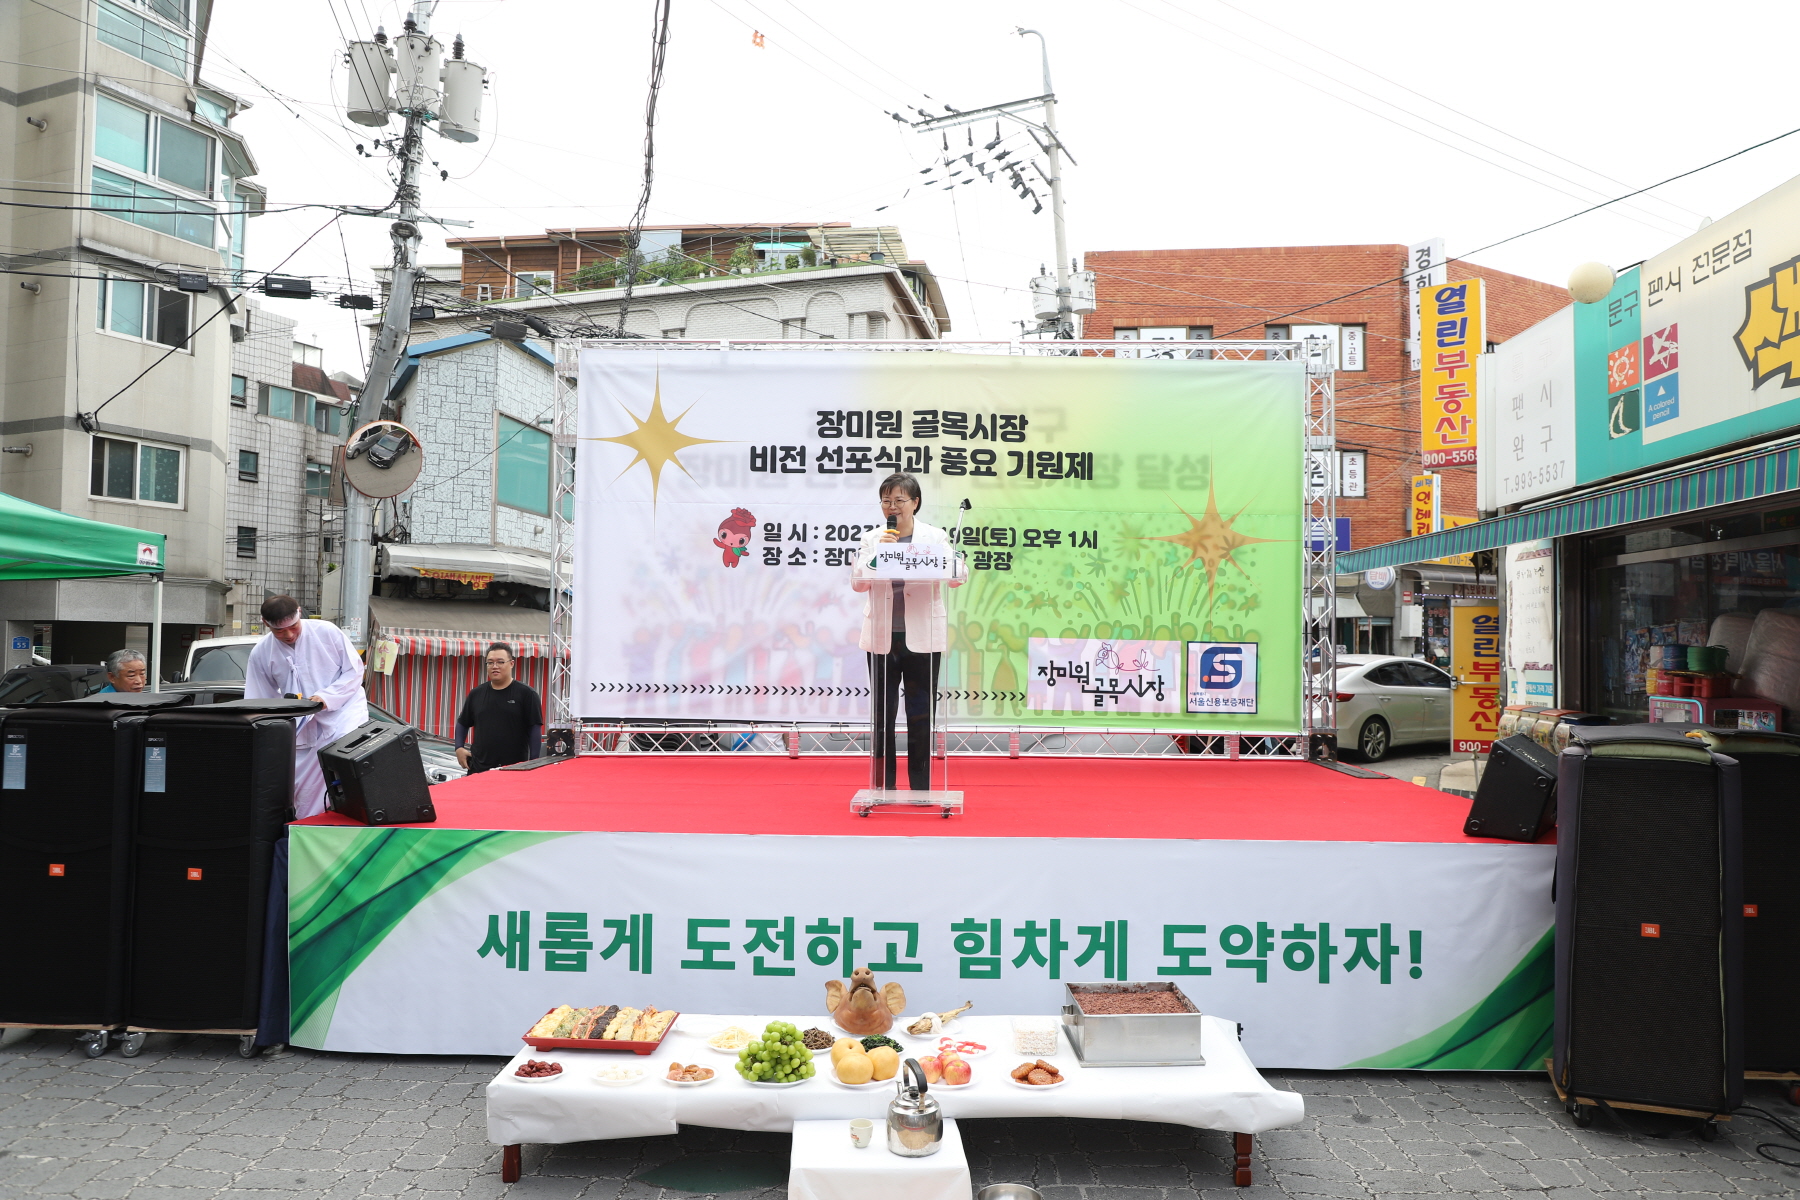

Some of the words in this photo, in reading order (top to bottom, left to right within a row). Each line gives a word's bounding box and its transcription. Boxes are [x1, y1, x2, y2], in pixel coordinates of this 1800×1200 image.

[1692, 228, 1752, 285] 전문점
[1608, 289, 1639, 328] 문구
[1434, 284, 1473, 446] 열린부동산
[1648, 404, 1654, 413] A
[1653, 396, 1675, 411] colored
[1652, 407, 1670, 422] pencil
[816, 409, 903, 440] 장미원
[911, 408, 1029, 443] 골목시장
[1512, 424, 1553, 462] 완구
[750, 445, 807, 474] 비전
[816, 445, 932, 475] 선포식과
[940, 446, 998, 477] 풍요
[1006, 449, 1094, 481] 기원제
[1504, 459, 1566, 495] T.993-5537
[825, 524, 880, 542] 202
[942, 526, 1016, 549] 9일(토)
[1023, 528, 1062, 548] 오후
[1068, 529, 1098, 550] 1시
[880, 551, 904, 564] 장미원
[903, 556, 939, 570] 골목시장
[973, 550, 1014, 571] 광장
[1369, 571, 1388, 581] 담배
[1037, 660, 1090, 693] 장미원
[1091, 674, 1165, 707] 골목시장
[1189, 696, 1255, 708] 서울신용보증재단
[1459, 740, 1493, 752] 900-
[1645, 926, 1657, 934] JBL
[477, 910, 653, 975] 새롭게
[681, 916, 923, 978] 도전하고
[951, 918, 1129, 981] 힘차게
[1157, 921, 1423, 985] 도약하자!
